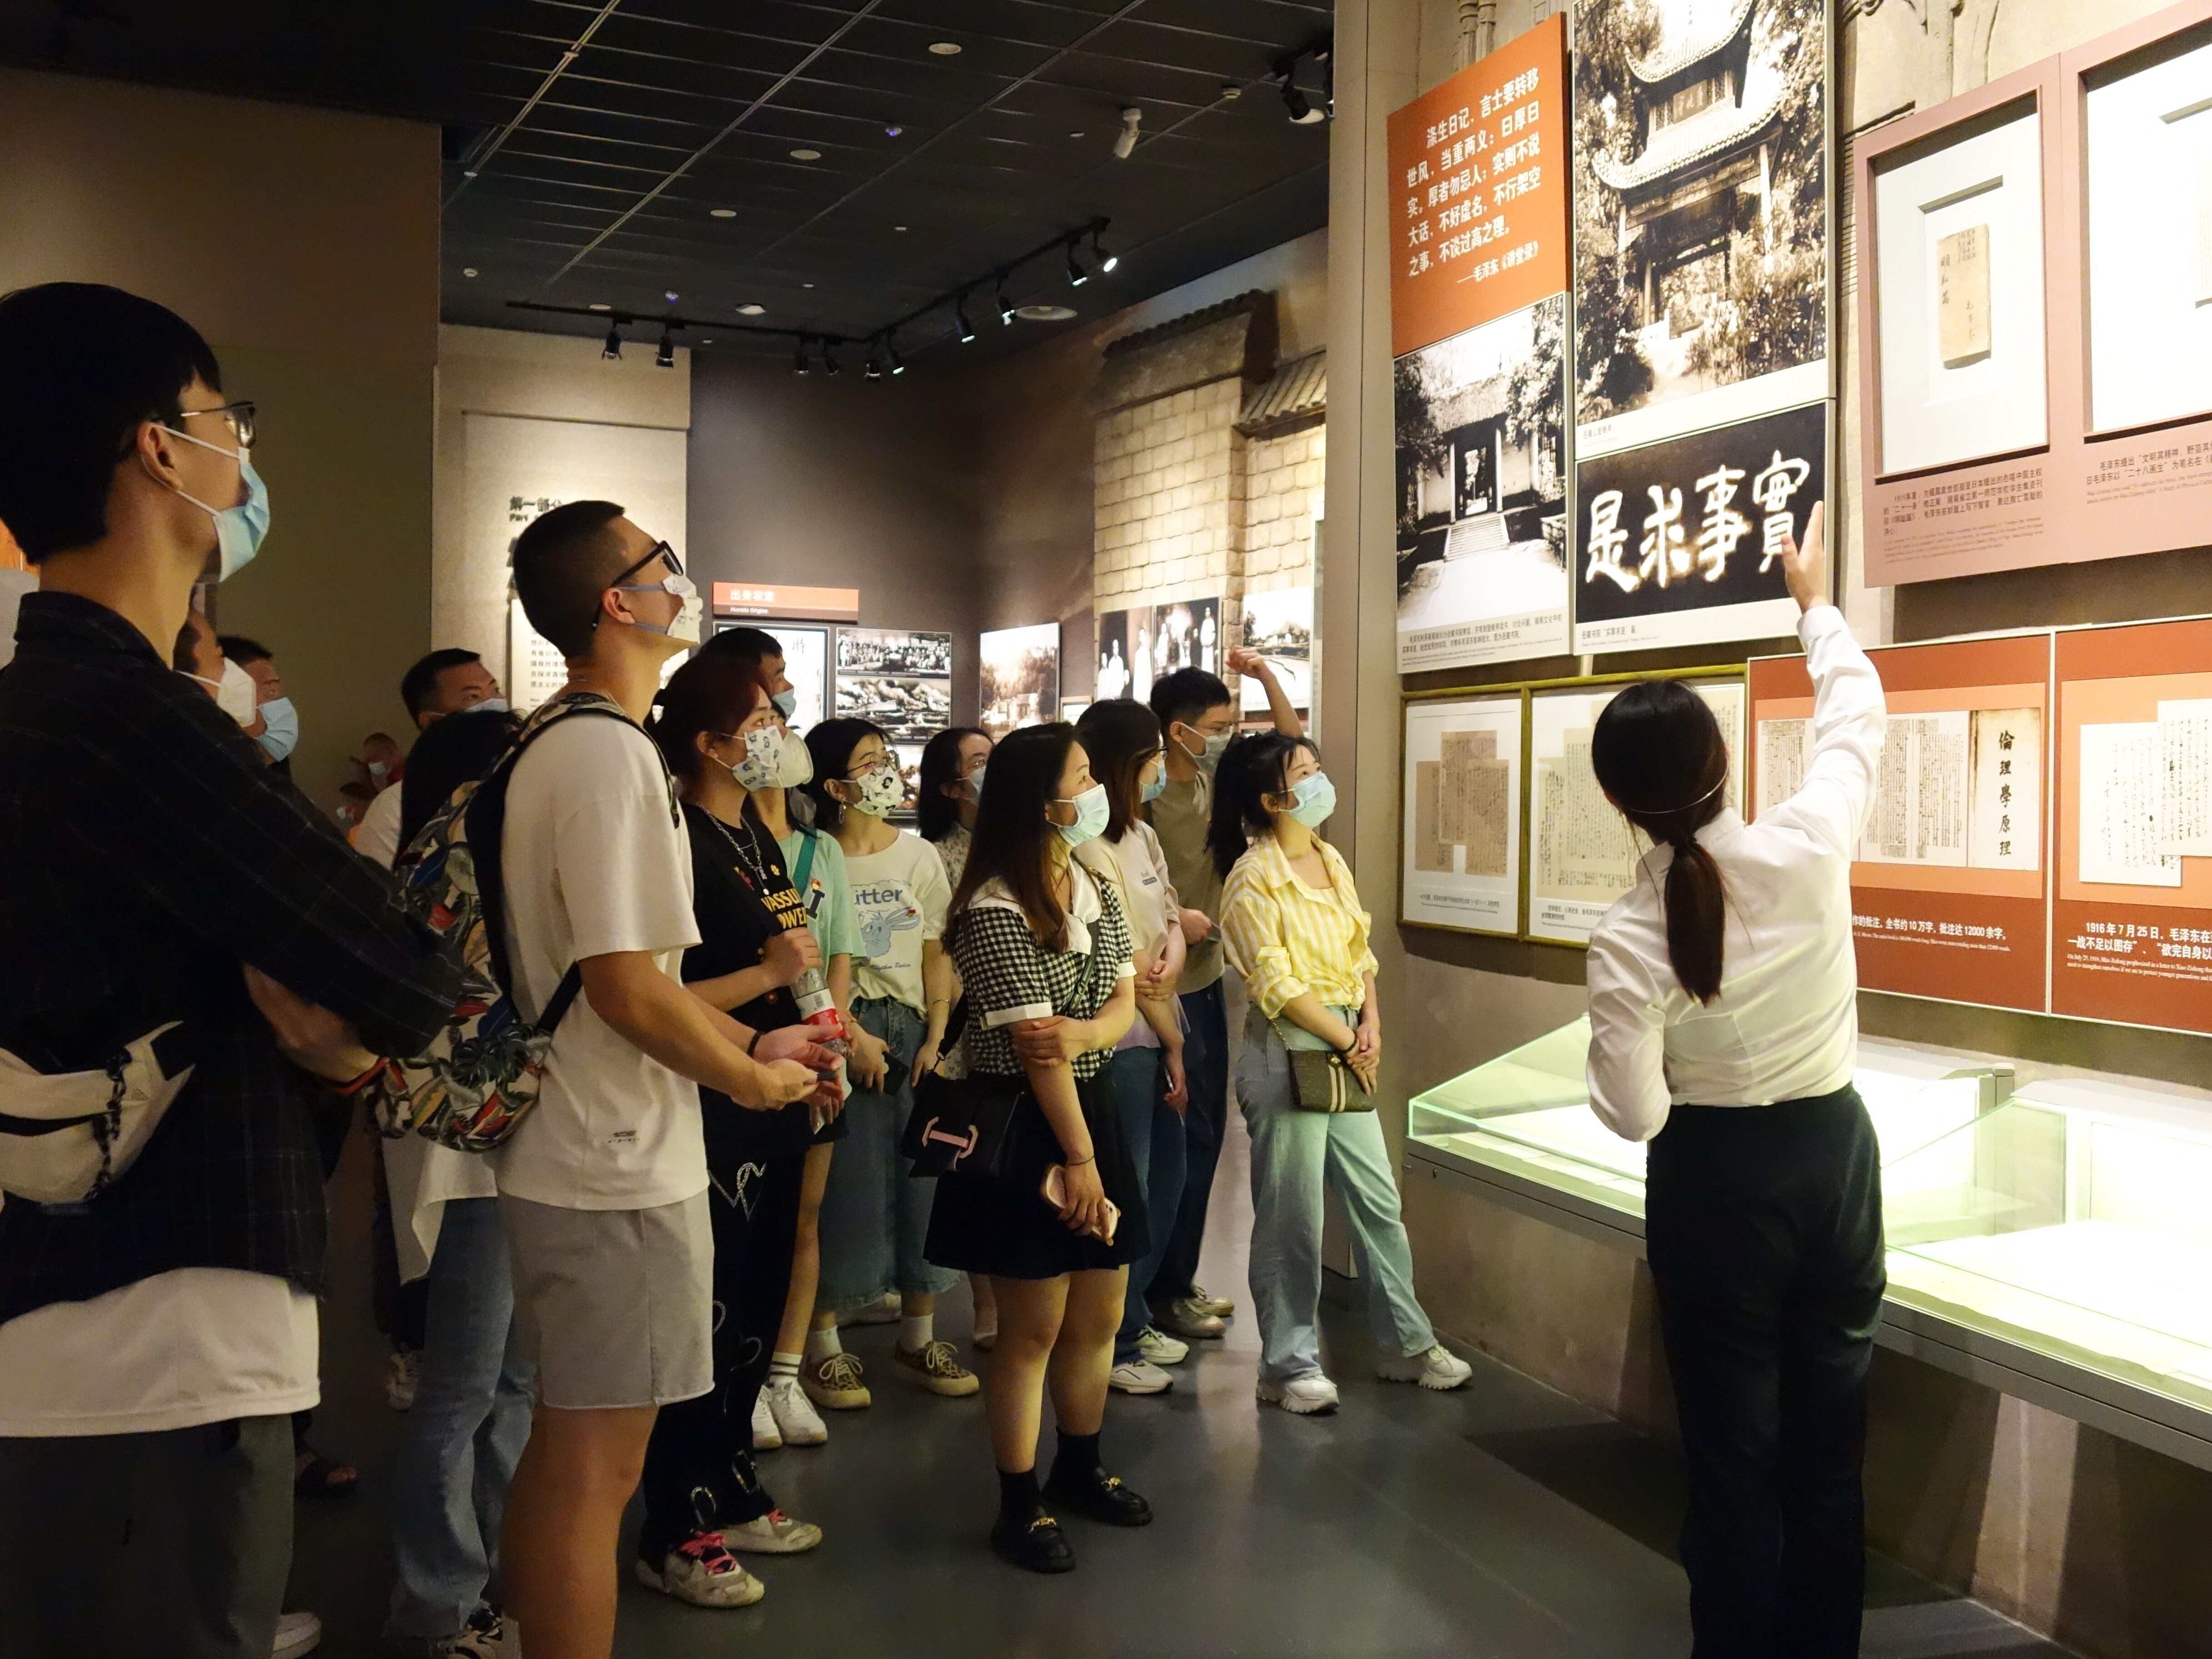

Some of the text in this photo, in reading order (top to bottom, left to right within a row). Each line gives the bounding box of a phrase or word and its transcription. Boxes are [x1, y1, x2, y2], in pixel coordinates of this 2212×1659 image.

[1998, 728, 2016, 858] 倫理學原理
